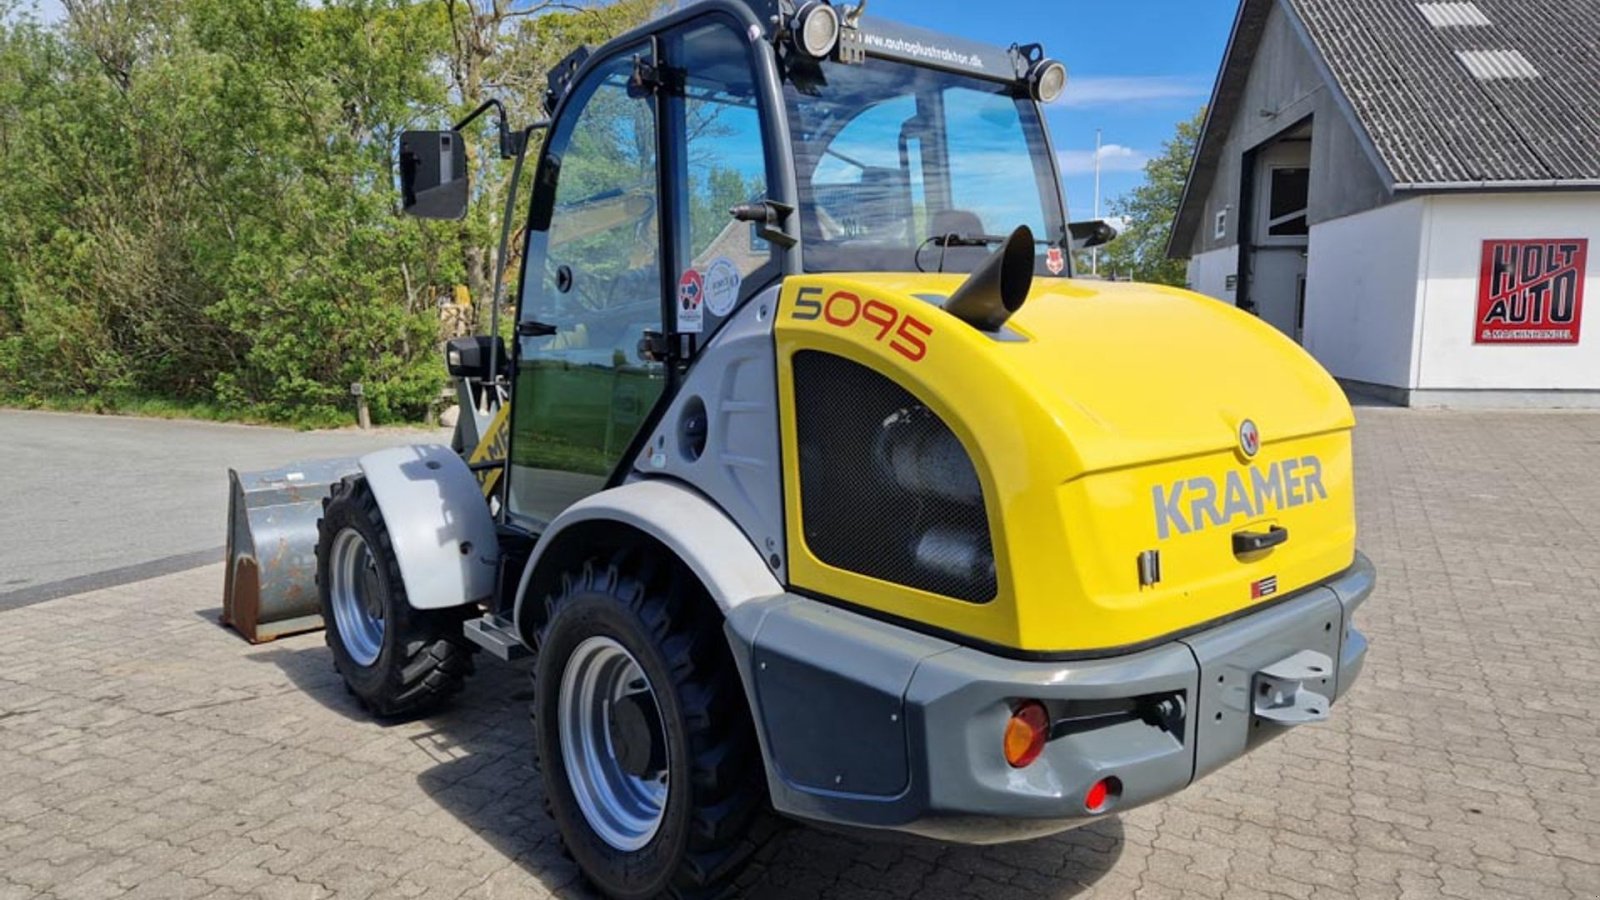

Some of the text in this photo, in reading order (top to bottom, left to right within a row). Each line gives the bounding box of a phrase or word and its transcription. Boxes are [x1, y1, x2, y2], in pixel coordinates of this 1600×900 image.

[858, 32, 984, 68] ww.autoplustraktor.dk
[1482, 267, 1578, 324] AUTO
[1489, 243, 1579, 300] HOLT
[791, 286, 933, 362] 5095
[1152, 455, 1327, 540] KRAMER
